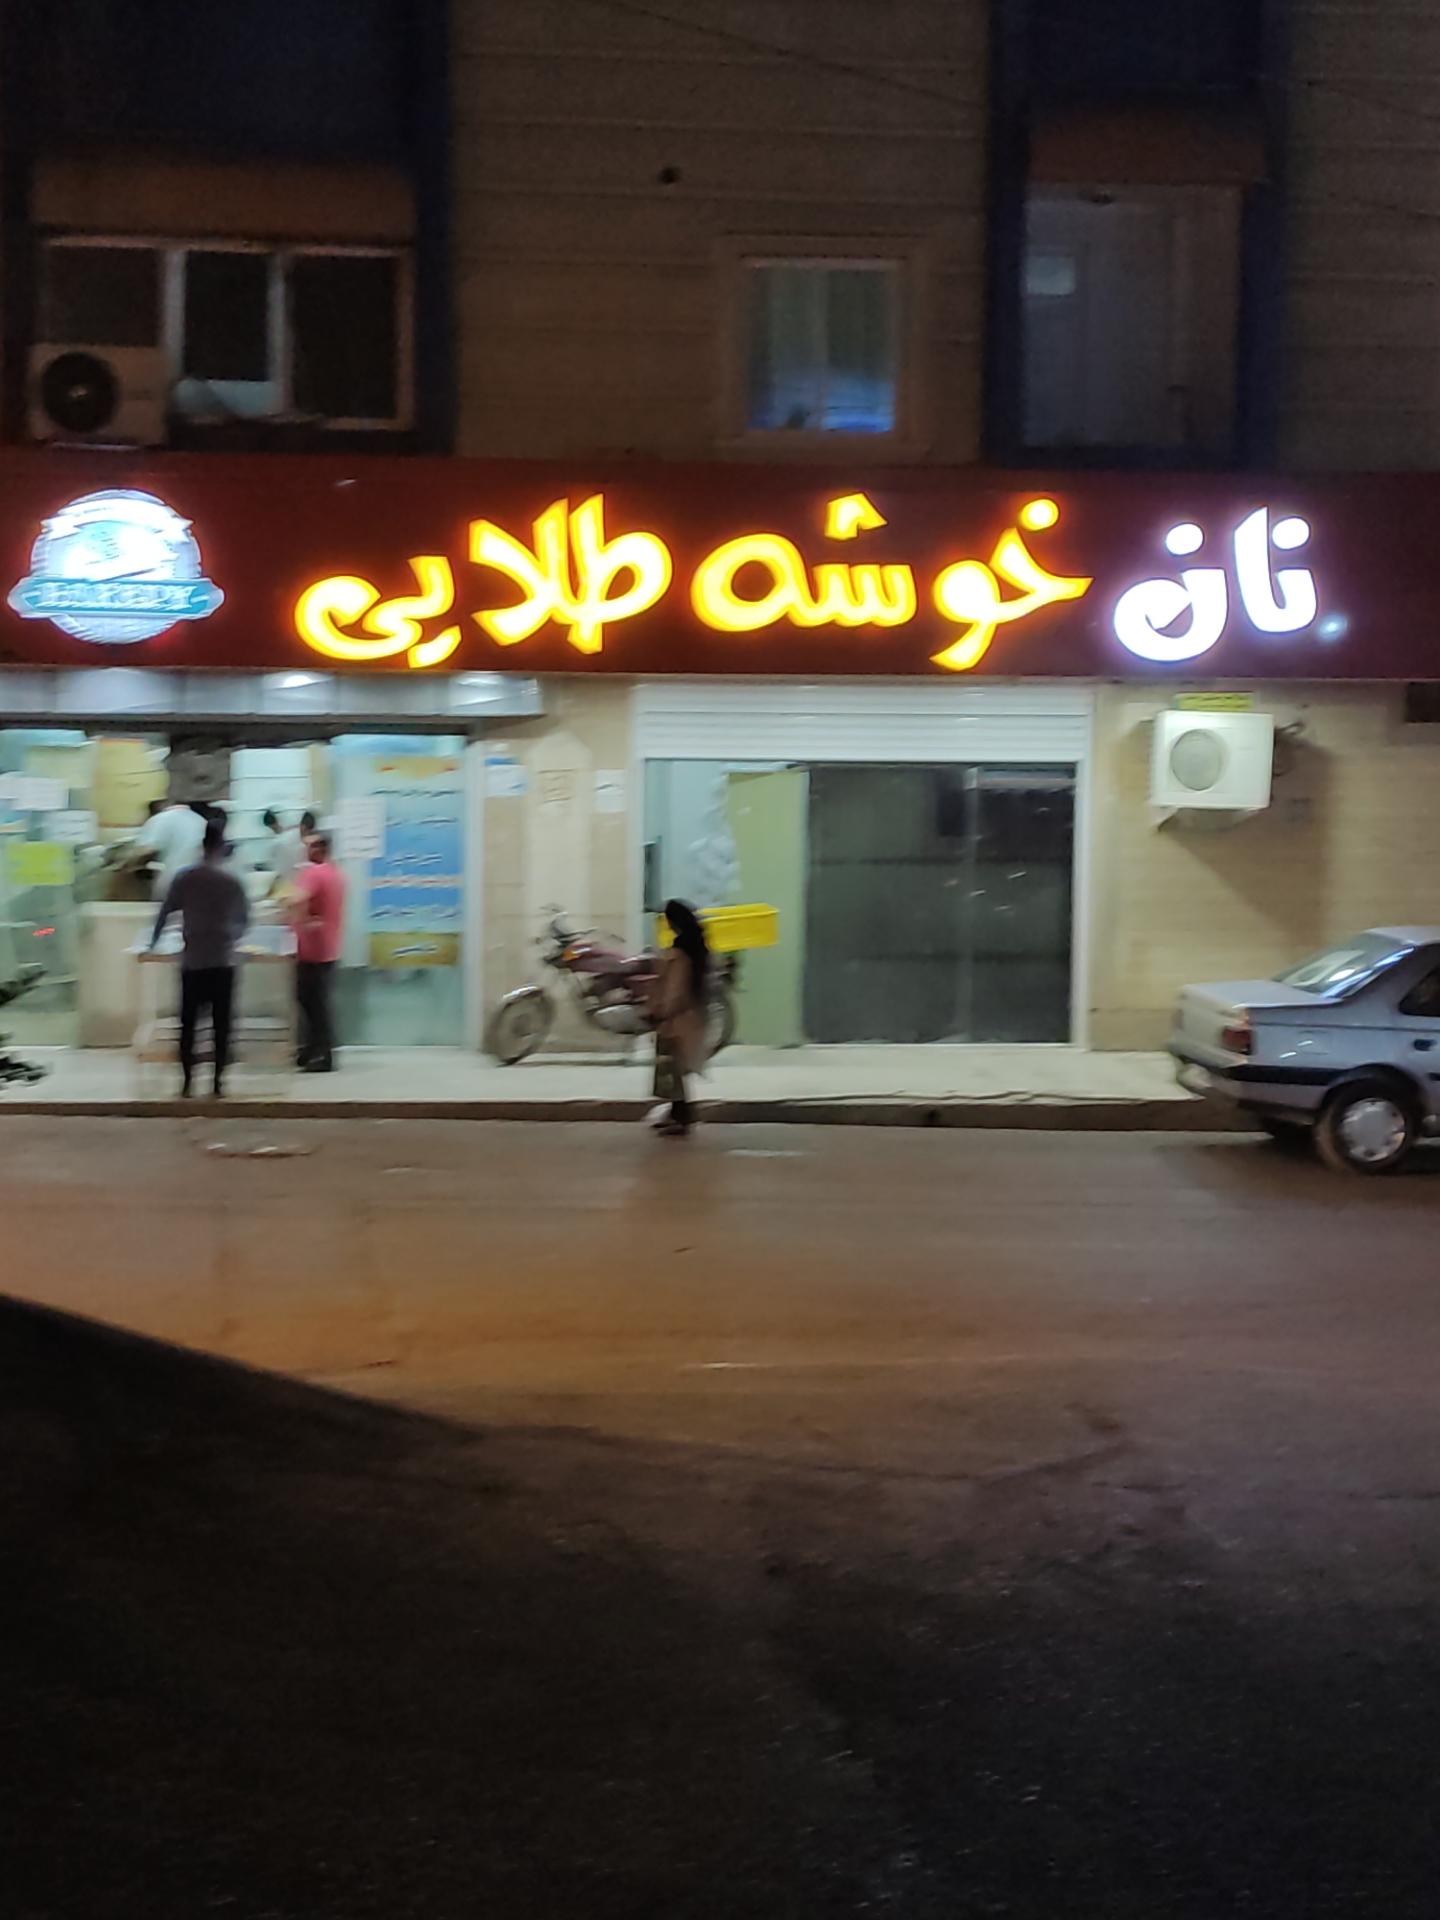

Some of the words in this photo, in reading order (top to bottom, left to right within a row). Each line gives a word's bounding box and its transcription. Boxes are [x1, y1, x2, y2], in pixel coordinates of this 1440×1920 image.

[294, 493, 673, 669] طلایی
[690, 492, 1093, 672] خوشه
[1113, 506, 1319, 662] نان
